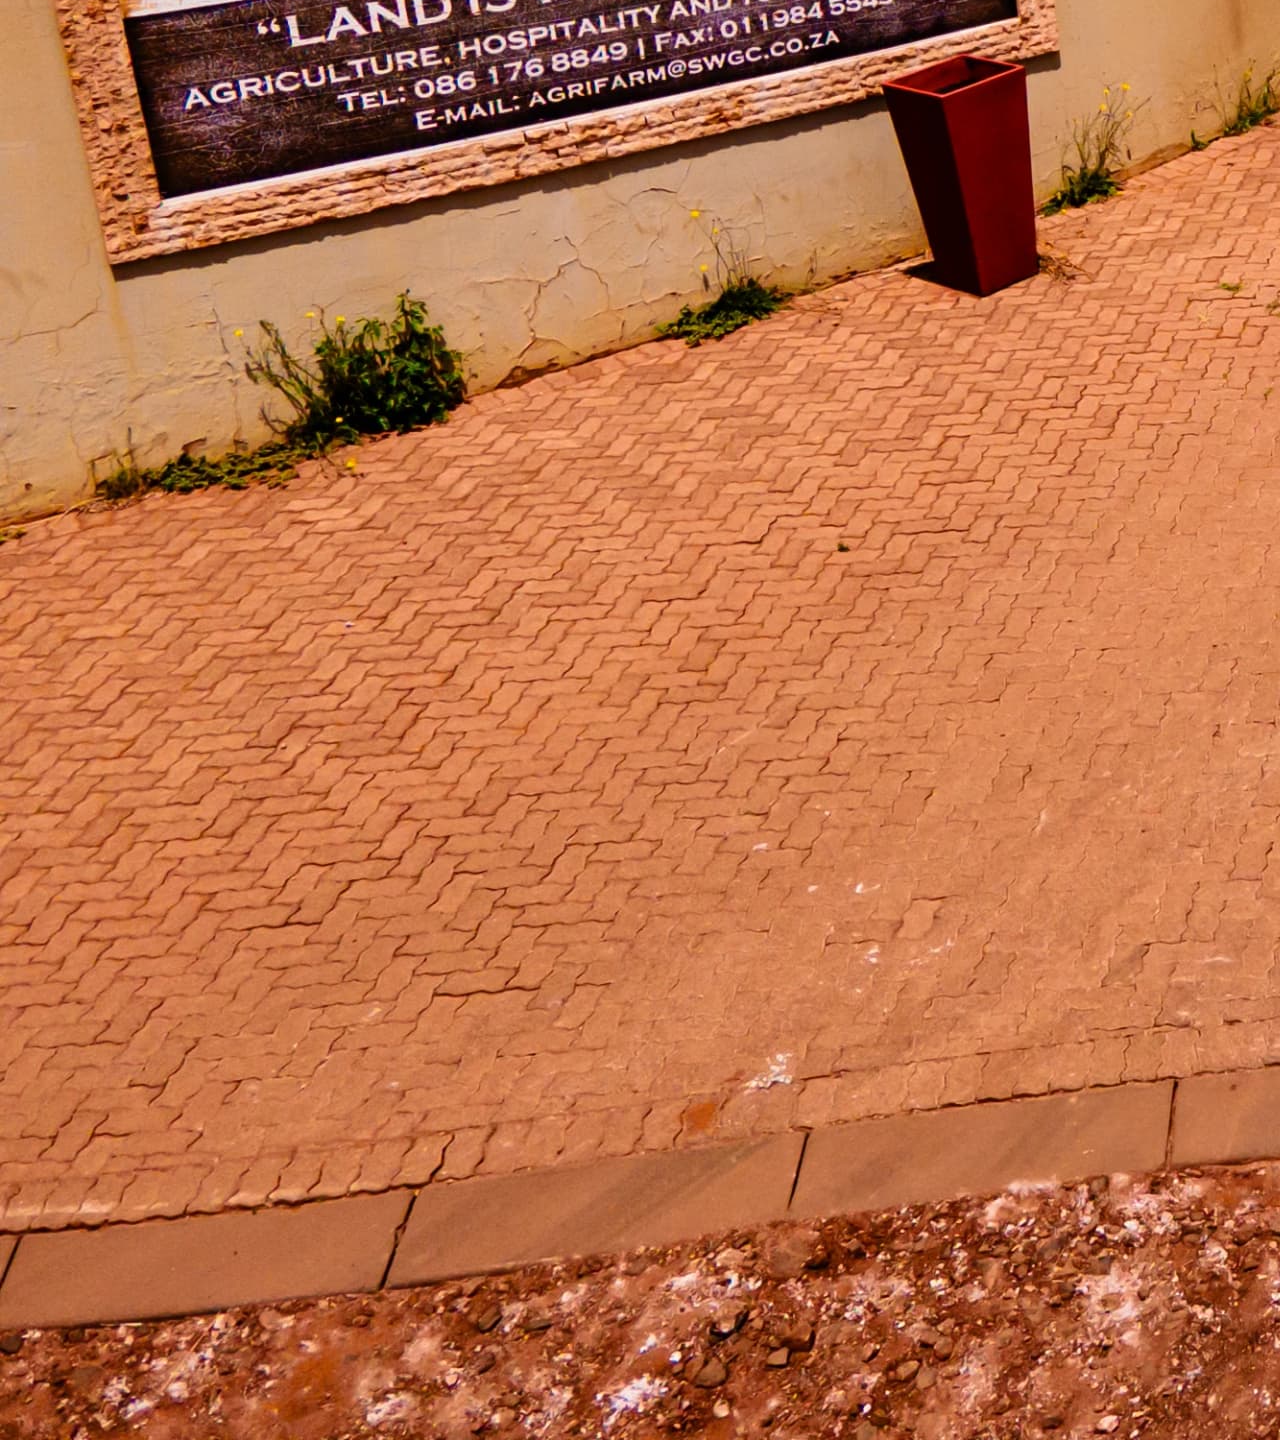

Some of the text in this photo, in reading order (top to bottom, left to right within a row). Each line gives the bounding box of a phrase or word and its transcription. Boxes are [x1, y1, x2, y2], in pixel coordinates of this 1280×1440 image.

[184, 45, 452, 111] AGRICULTURE,
[457, 3, 662, 62] HOSPITALITY
[336, 87, 407, 113] TEL:
[413, 70, 478, 100] 086
[488, 57, 545, 85] 176
[551, 41, 628, 73] 8849
[654, 25, 714, 53] FAX:
[414, 29, 841, 132] E-MAIL: AGRIFARM@SWGC.CO.ZA
